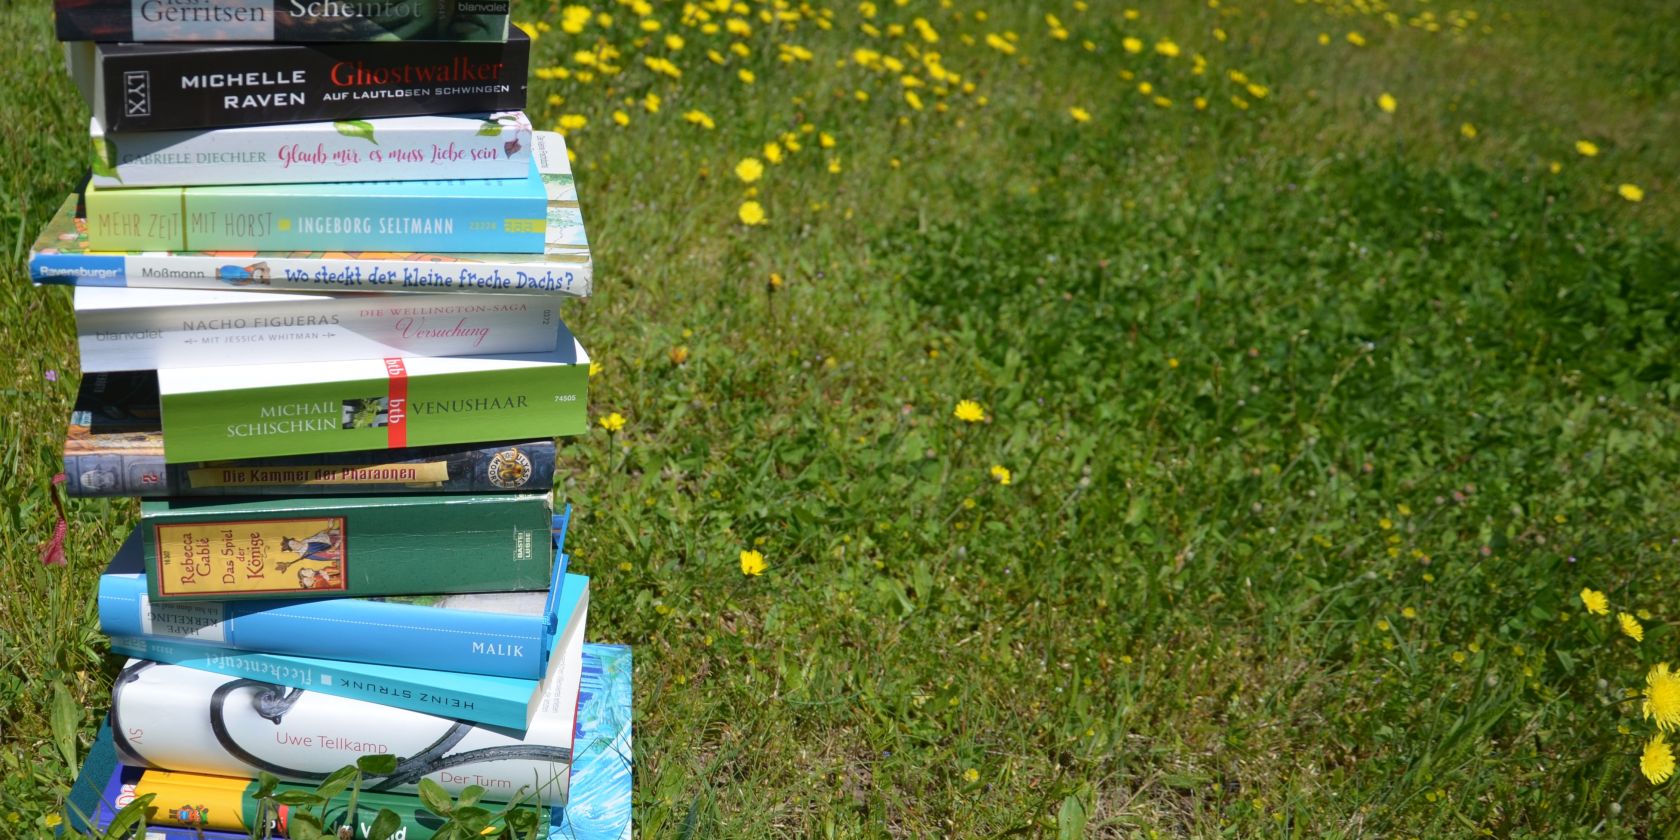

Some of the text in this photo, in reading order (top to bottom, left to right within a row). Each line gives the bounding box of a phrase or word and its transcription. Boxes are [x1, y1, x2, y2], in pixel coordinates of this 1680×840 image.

[141, 0, 266, 22] Gerritsen
[289, 0, 422, 18] Scheintot
[458, 2, 508, 12] blanvalet
[181, 71, 306, 89] MICHELLE
[330, 55, 503, 87] Ghostwalker
[127, 75, 146, 114] LYX
[224, 92, 306, 109] RAVEN
[323, 84, 510, 101] AUF LAUTLOSEN SCHWINGEN
[122, 152, 193, 165] GABRIELE
[278, 143, 328, 168] Glaub
[369, 150, 382, 162] es
[388, 148, 424, 162] muss
[471, 147, 497, 161] sein
[98, 212, 273, 240] MEHR ZEIT MIT HORST
[298, 217, 371, 234] INGEBORG
[379, 217, 454, 235] SELTMANN
[40, 266, 118, 279] Ravensburger
[142, 267, 205, 280] Moßmann
[284, 266, 574, 291] Wo steckt der kleine freche Dachs?
[360, 303, 528, 318] DIE WELLINGTON-SAGA
[183, 314, 339, 331] NACHO FIGUERAS
[96, 328, 163, 342] blanvalet
[202, 332, 319, 344] MIT JESSICA WHITMAN
[395, 317, 490, 347] Versuchung
[386, 358, 405, 376] btb
[412, 395, 528, 415] VENUSHAAR
[554, 394, 577, 402] 74505
[260, 401, 337, 418] MICHAIL
[390, 399, 404, 424] btb
[227, 417, 337, 438] SCHISCHKIN
[223, 467, 416, 484] Die Kammer der Pharaonen
[181, 532, 196, 586] Rebecca
[220, 529, 236, 585] Das Spiel
[237, 547, 245, 562] der
[246, 532, 264, 580] Könige
[147, 611, 218, 628] KERKELING
[167, 624, 200, 636] HAPE
[472, 641, 524, 657] MALIK
[340, 678, 474, 711] HEINZ STRUNK
[275, 731, 388, 754] Uwe Tellkamp
[440, 771, 511, 789] Der Turm
